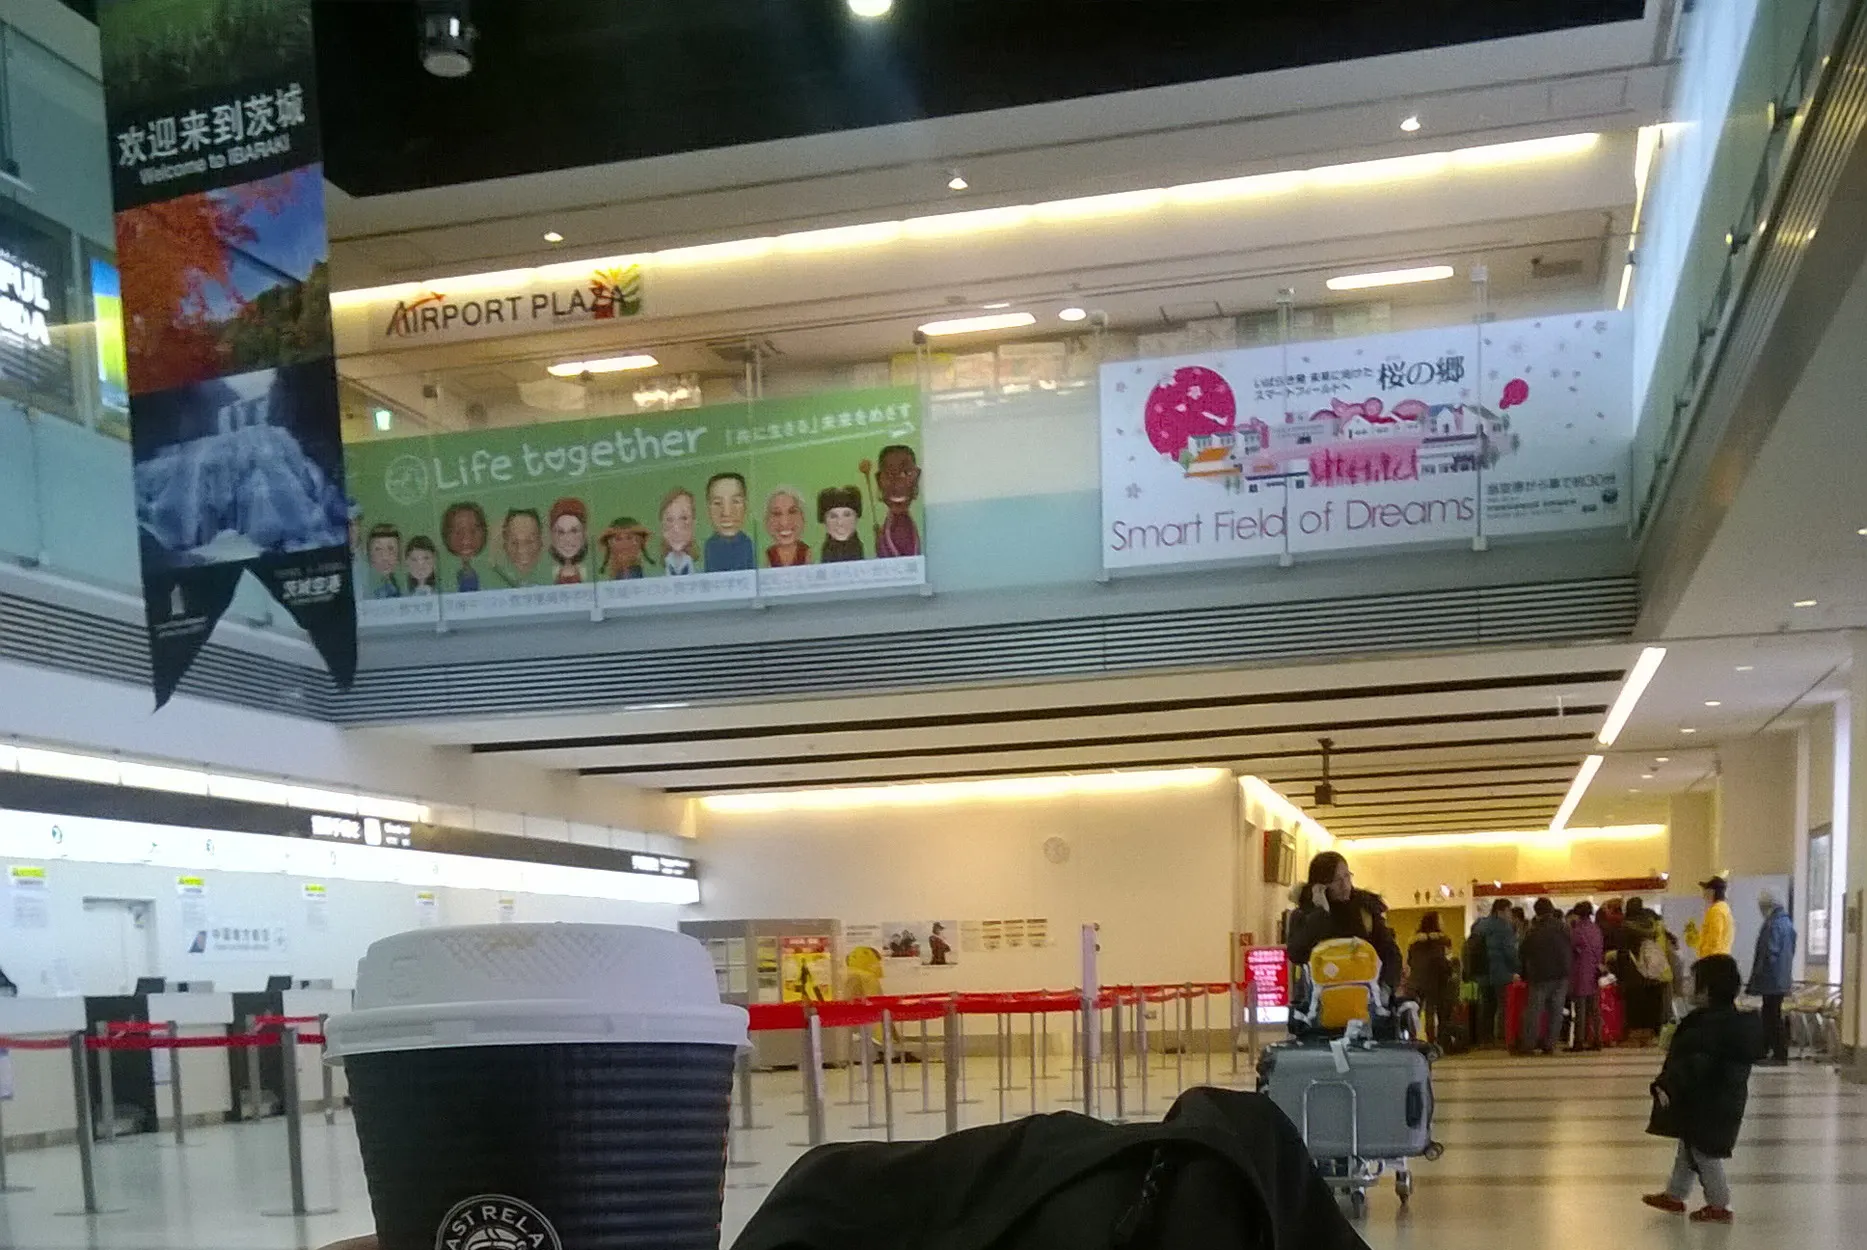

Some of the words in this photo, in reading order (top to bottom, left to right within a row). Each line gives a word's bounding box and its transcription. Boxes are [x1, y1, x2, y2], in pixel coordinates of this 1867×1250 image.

[117, 82, 305, 166] 欢迎来到茨城
[139, 157, 207, 185] Welcome
[208, 152, 226, 169] to
[386, 295, 522, 336] AIRPORT
[531, 285, 626, 319] PLAZA
[1379, 356, 1464, 391] 桜の郷
[434, 450, 513, 489] Life
[522, 426, 707, 476] together
[1111, 514, 1202, 551] Smart
[1215, 507, 1287, 541] Field
[1300, 499, 1333, 534] of
[1347, 496, 1475, 530] Dreams
